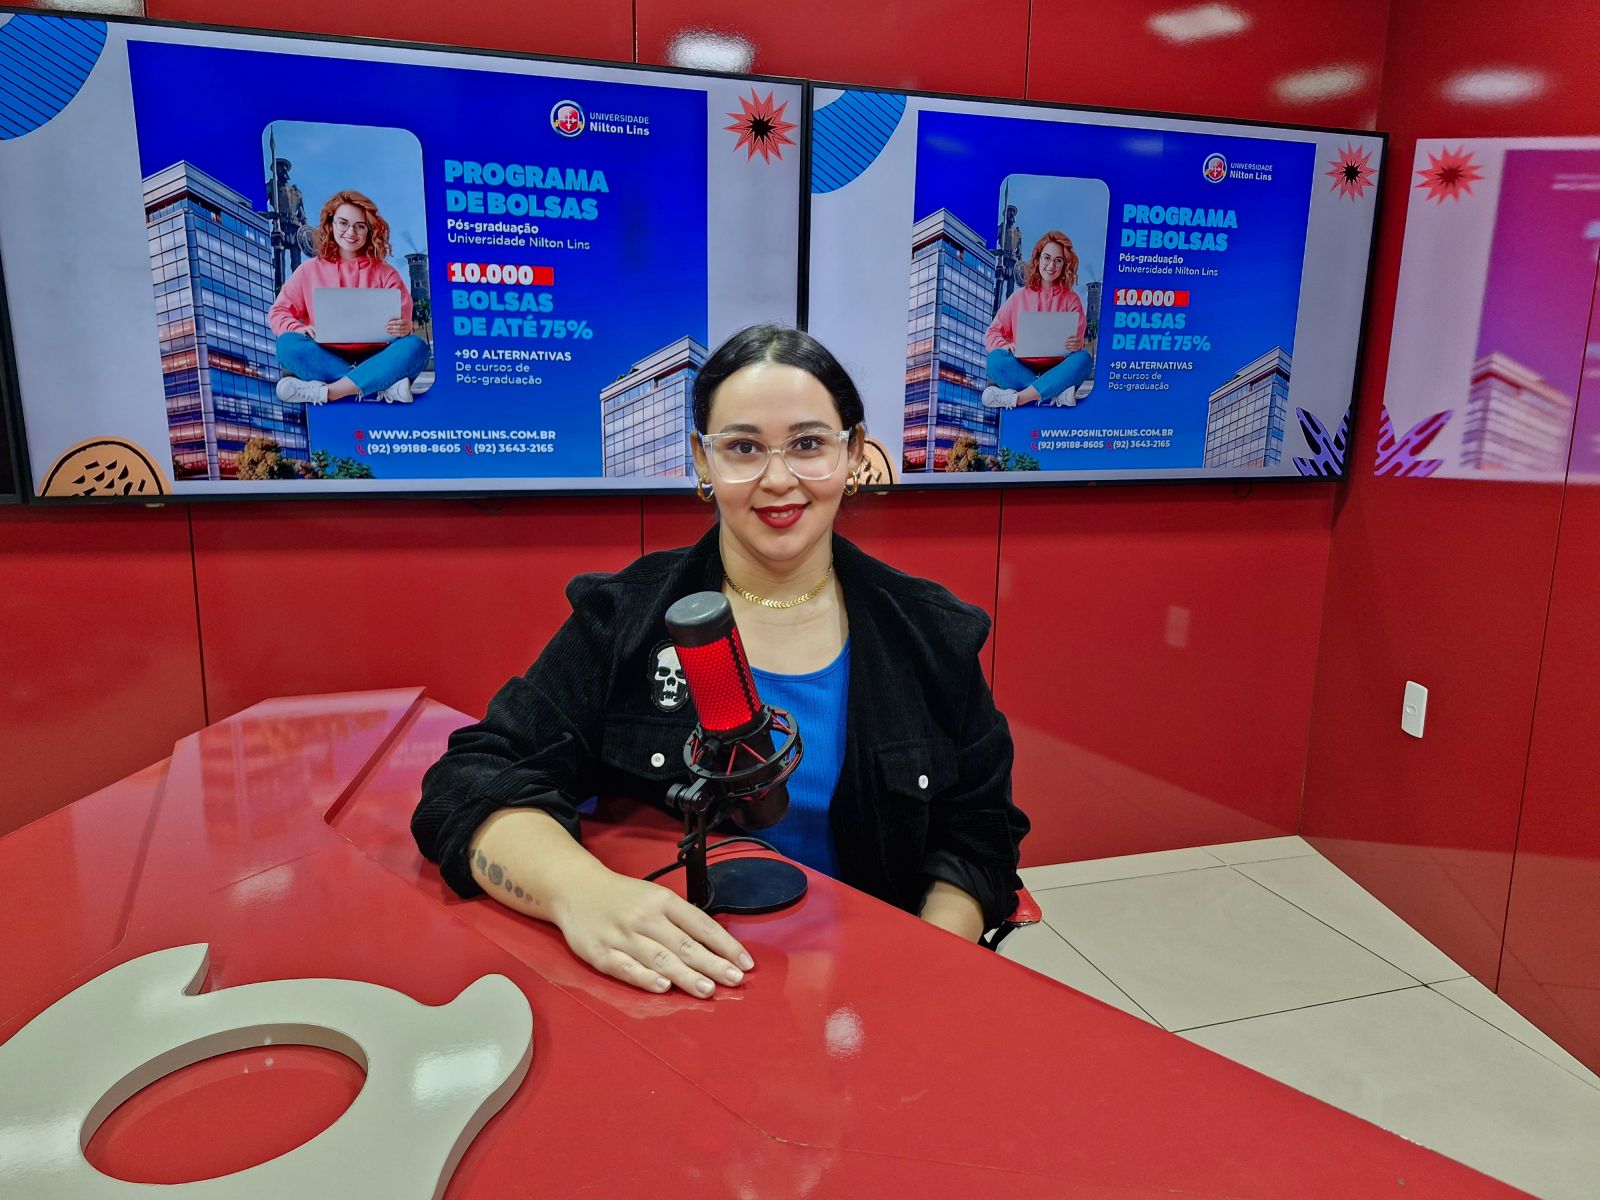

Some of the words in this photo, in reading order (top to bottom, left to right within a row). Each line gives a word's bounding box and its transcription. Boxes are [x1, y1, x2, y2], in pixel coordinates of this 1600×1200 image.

[589, 112, 649, 125] UNIVERSIDADE
[590, 122, 624, 133] Nilton
[626, 124, 650, 136] Lins
[1230, 162, 1273, 172] UNIVERSIDADE
[444, 159, 609, 193] PROGRAMA
[1230, 170, 1254, 180] Nilton
[1255, 172, 1272, 181] Lins
[446, 189, 484, 214] DE
[487, 191, 598, 221] BOLSAS
[1123, 203, 1238, 229] PROGRAMA
[447, 219, 539, 234] Pós-graduação
[448, 233, 526, 247] Universidade
[529, 237, 564, 248] Nilton
[567, 239, 590, 250] Lins
[1120, 228, 1148, 248] DE
[1150, 229, 1228, 252] BOLSAS
[1119, 252, 1184, 264] Pós-graduação
[450, 262, 534, 285] 10.000
[1118, 264, 1173, 275] Universidade
[1175, 266, 1200, 275] Nilton
[1201, 267, 1218, 276] Lins
[452, 289, 554, 313] BOLSAS
[1116, 288, 1175, 307] 10.000
[1114, 311, 1186, 330] BOLSAS
[453, 316, 487, 336] DE
[490, 314, 538, 338] ATÉ
[540, 319, 593, 340] 75%
[1111, 333, 1137, 350] DE
[1137, 331, 1172, 351] ATÉ
[1173, 335, 1212, 352] 75%
[455, 349, 478, 359] +90
[482, 350, 572, 362] ALTERNATIVAS
[455, 361, 472, 372] De
[475, 363, 512, 372] cursos
[515, 362, 530, 373] de
[1129, 361, 1193, 370] ALTERNATIVAS
[456, 374, 542, 386] Pós-graduação
[1109, 371, 1121, 380] De
[1122, 372, 1149, 380] cursos
[1151, 371, 1162, 380] de
[1108, 381, 1169, 392] Pós-graduação
[368, 429, 556, 440] WWW.POSNILTONLINS.COM.BR
[1041, 428, 1174, 438] WWW.POSNILTONLINS.COM.BR
[367, 443, 391, 455] (92)
[393, 443, 461, 454] 99188-8605
[474, 443, 497, 454] (92)
[498, 443, 554, 453] 3643-2165
[1037, 441, 1054, 451] (92)
[1113, 440, 1129, 450] (92)
